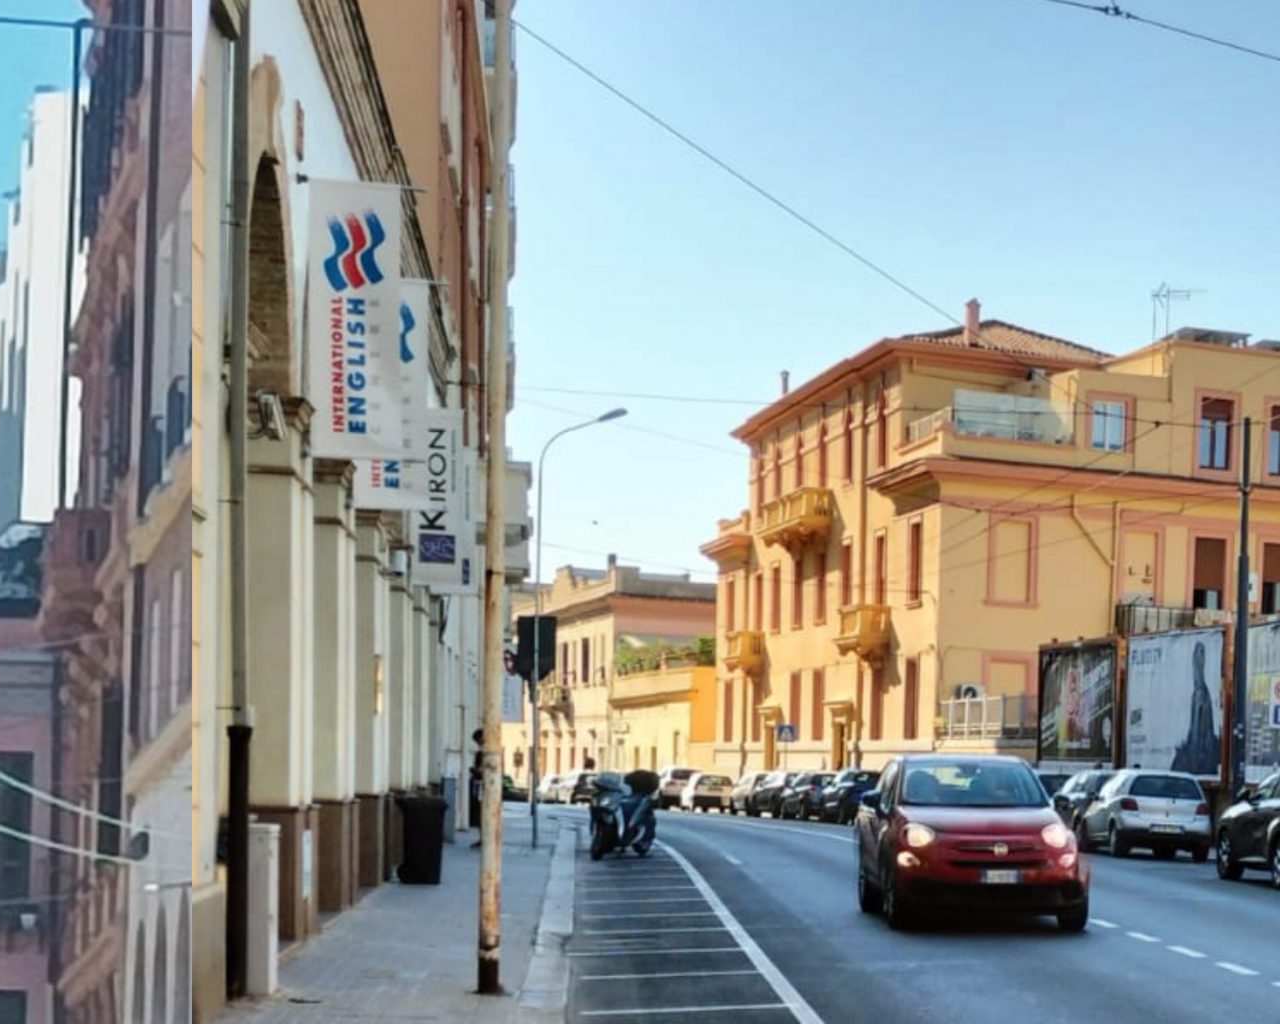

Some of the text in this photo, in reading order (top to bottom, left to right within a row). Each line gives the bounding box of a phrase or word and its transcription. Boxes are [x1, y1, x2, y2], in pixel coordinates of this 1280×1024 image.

[331, 296, 345, 433] INTERNATIONAL
[346, 297, 367, 434] ENGLISH
[418, 428, 447, 531] KIRON
